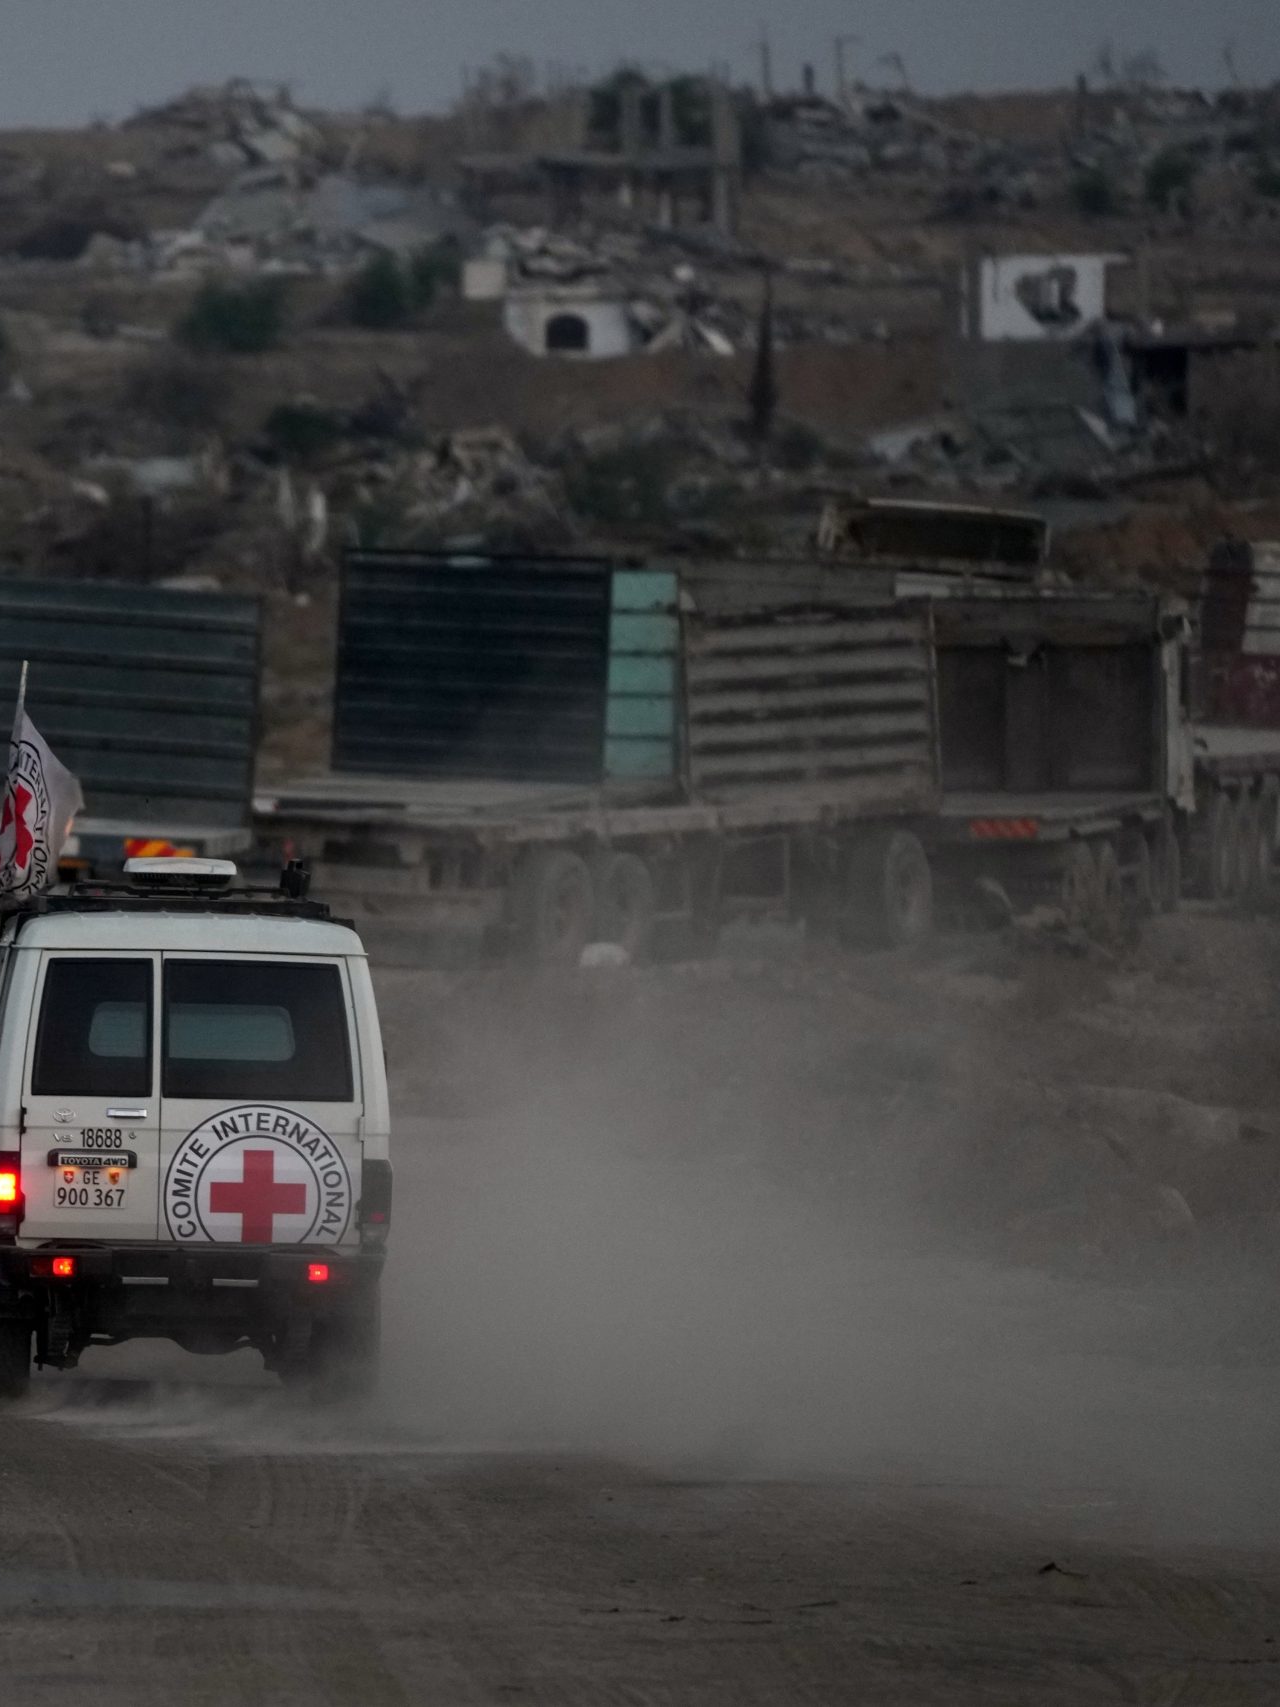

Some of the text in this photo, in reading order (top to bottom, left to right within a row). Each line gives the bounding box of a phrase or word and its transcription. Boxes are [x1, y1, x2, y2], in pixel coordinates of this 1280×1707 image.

[80, 1129, 122, 1148] 18688
[62, 1157, 101, 1165] TOYOTA
[83, 1171, 100, 1185] GE
[172, 1112, 344, 1238] COMITE INTERNATIONAL
[57, 1187, 125, 1207] 900 367
